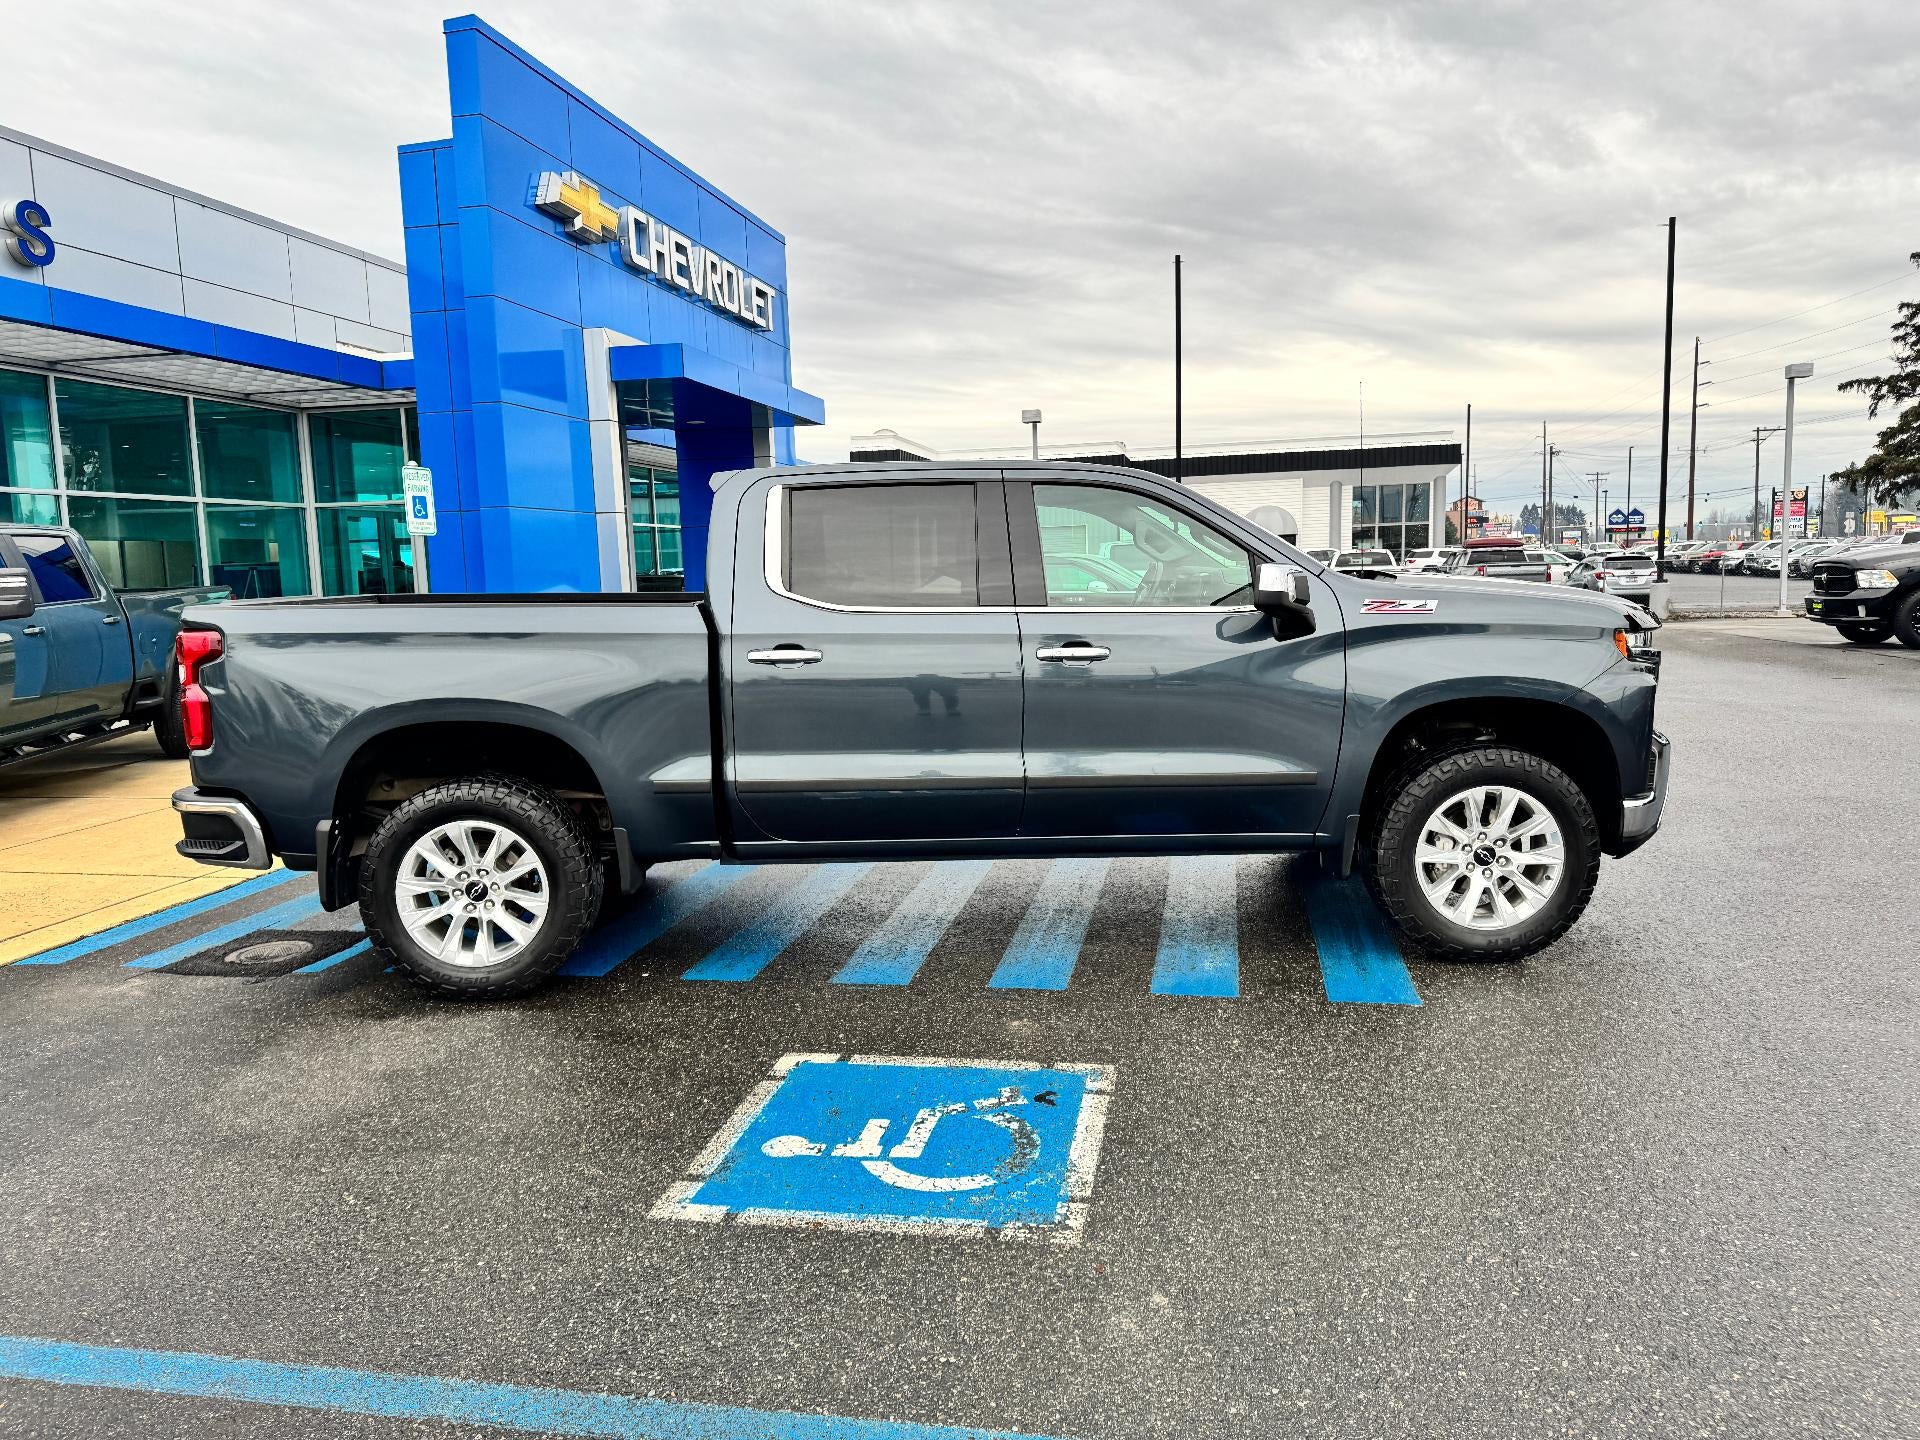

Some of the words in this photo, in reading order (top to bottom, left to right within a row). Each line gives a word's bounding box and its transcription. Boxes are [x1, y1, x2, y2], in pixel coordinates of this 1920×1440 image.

[619, 205, 776, 332] CHEVROLET
[407, 483, 429, 493] PARKING
[1360, 599, 1439, 614] Z71
